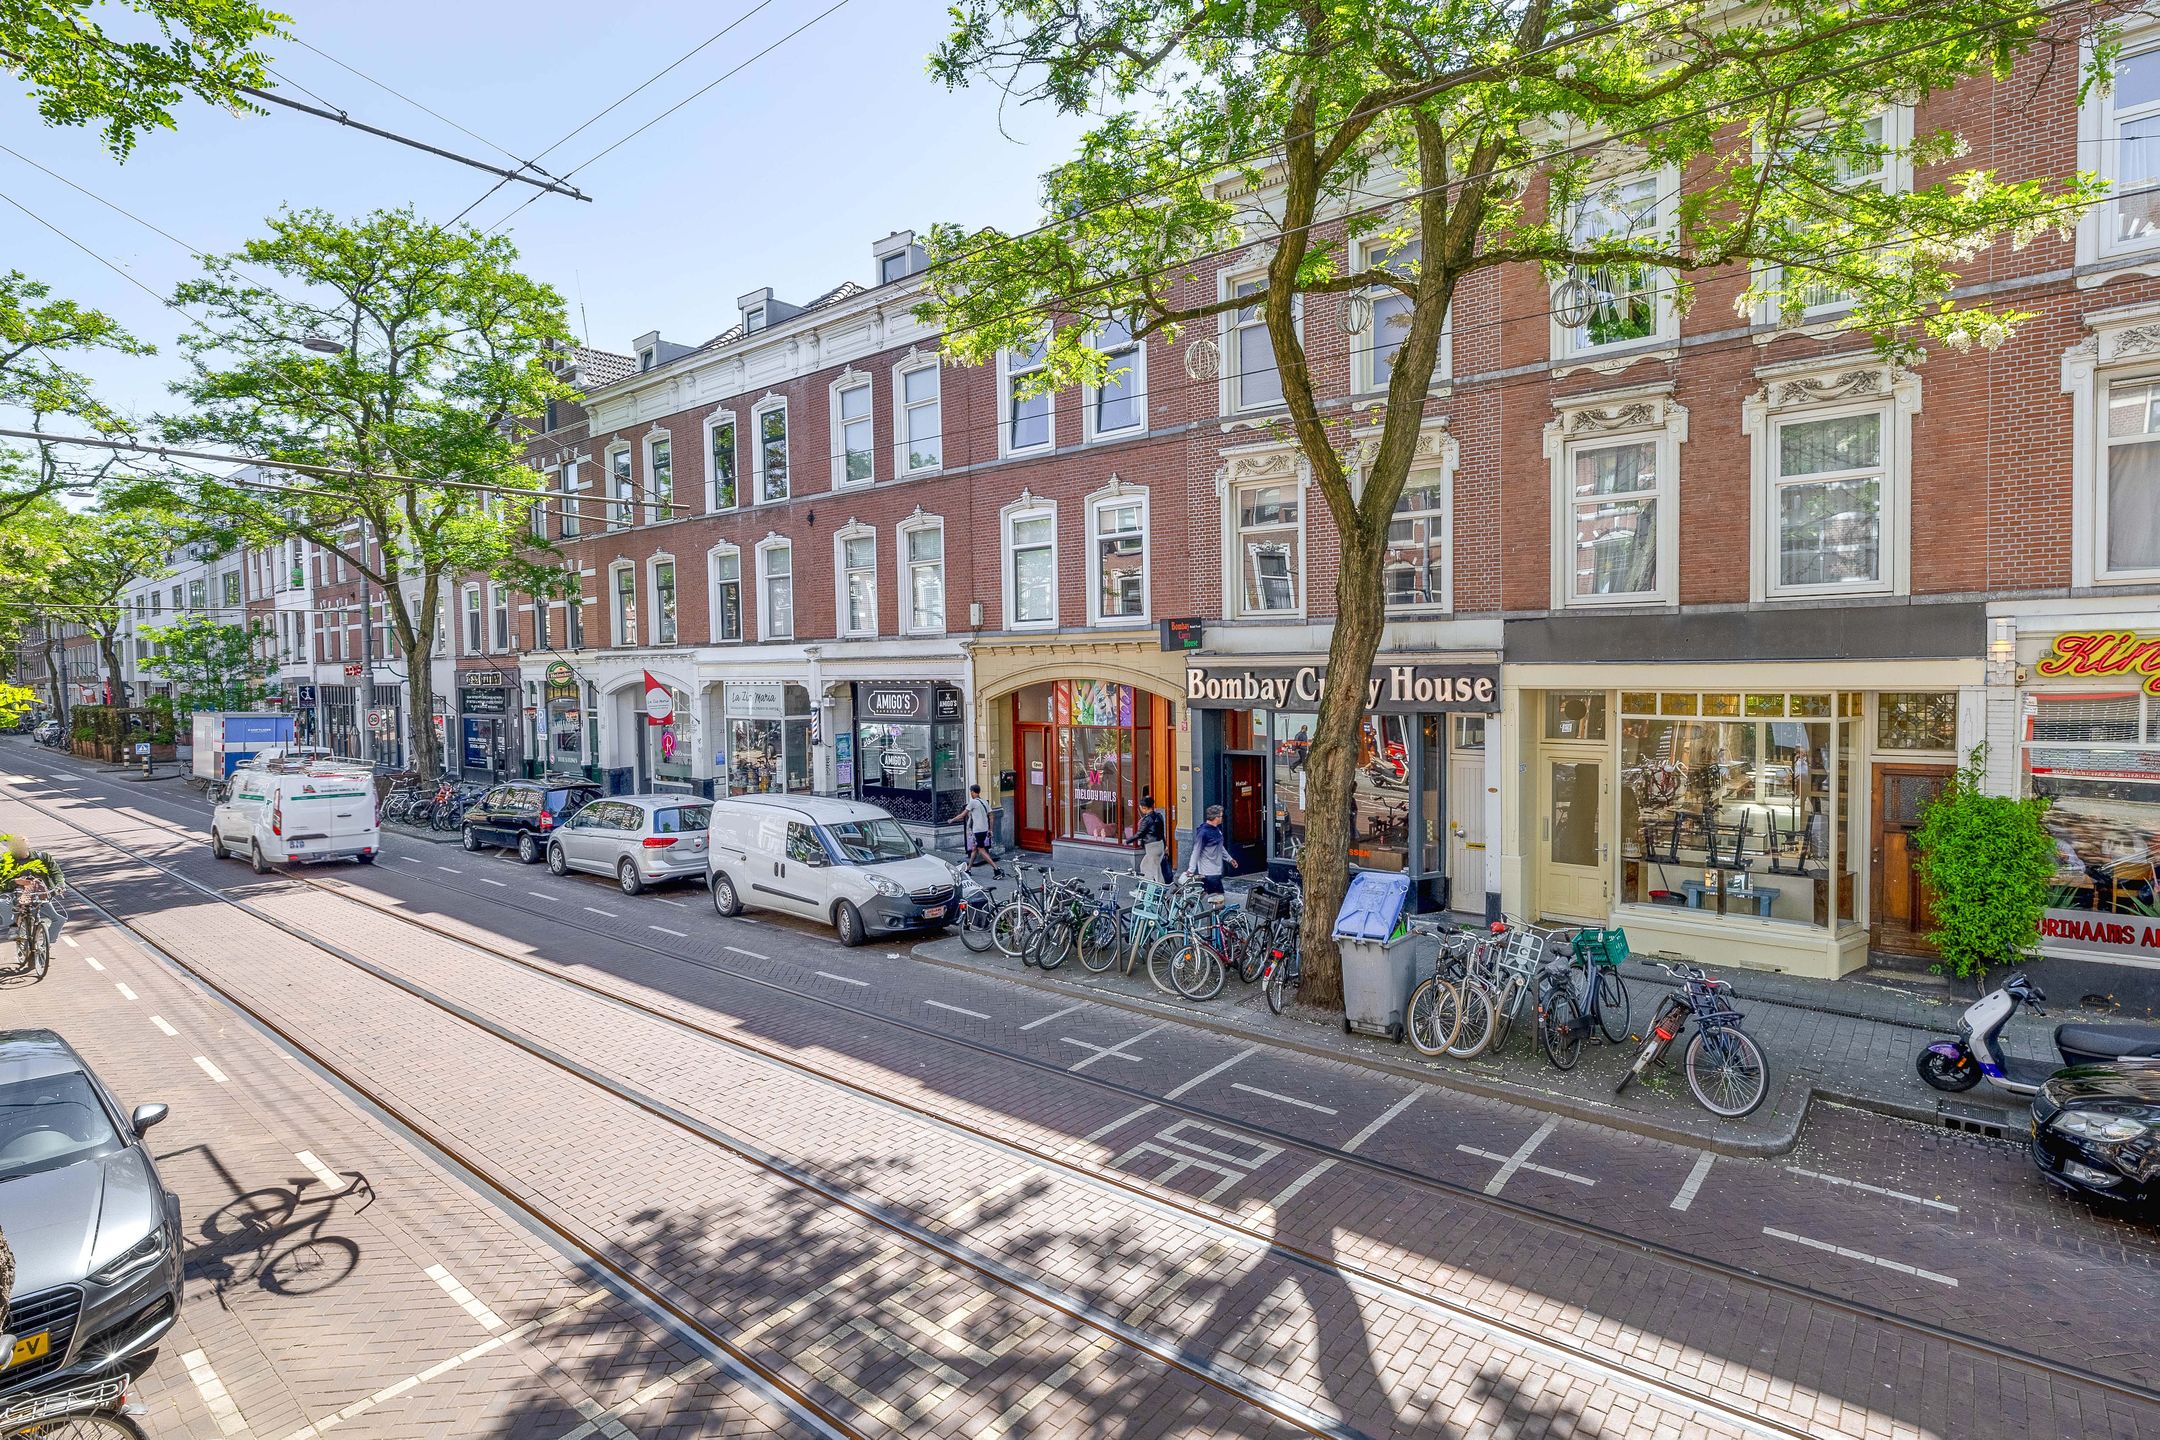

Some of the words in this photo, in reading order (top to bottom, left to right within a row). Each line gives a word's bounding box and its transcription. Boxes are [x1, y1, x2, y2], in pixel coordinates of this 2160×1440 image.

[1171, 621, 1190, 632] Bombay
[1183, 639, 1199, 648] House
[1187, 667, 1292, 708] Bombay
[1389, 666, 1494, 702] House
[741, 691, 753, 703] Zi
[876, 693, 911, 710] AMIGO'S
[538, 710, 544, 723] P
[885, 755, 907, 766] AMIGO'S
[1089, 770, 1101, 785] M
